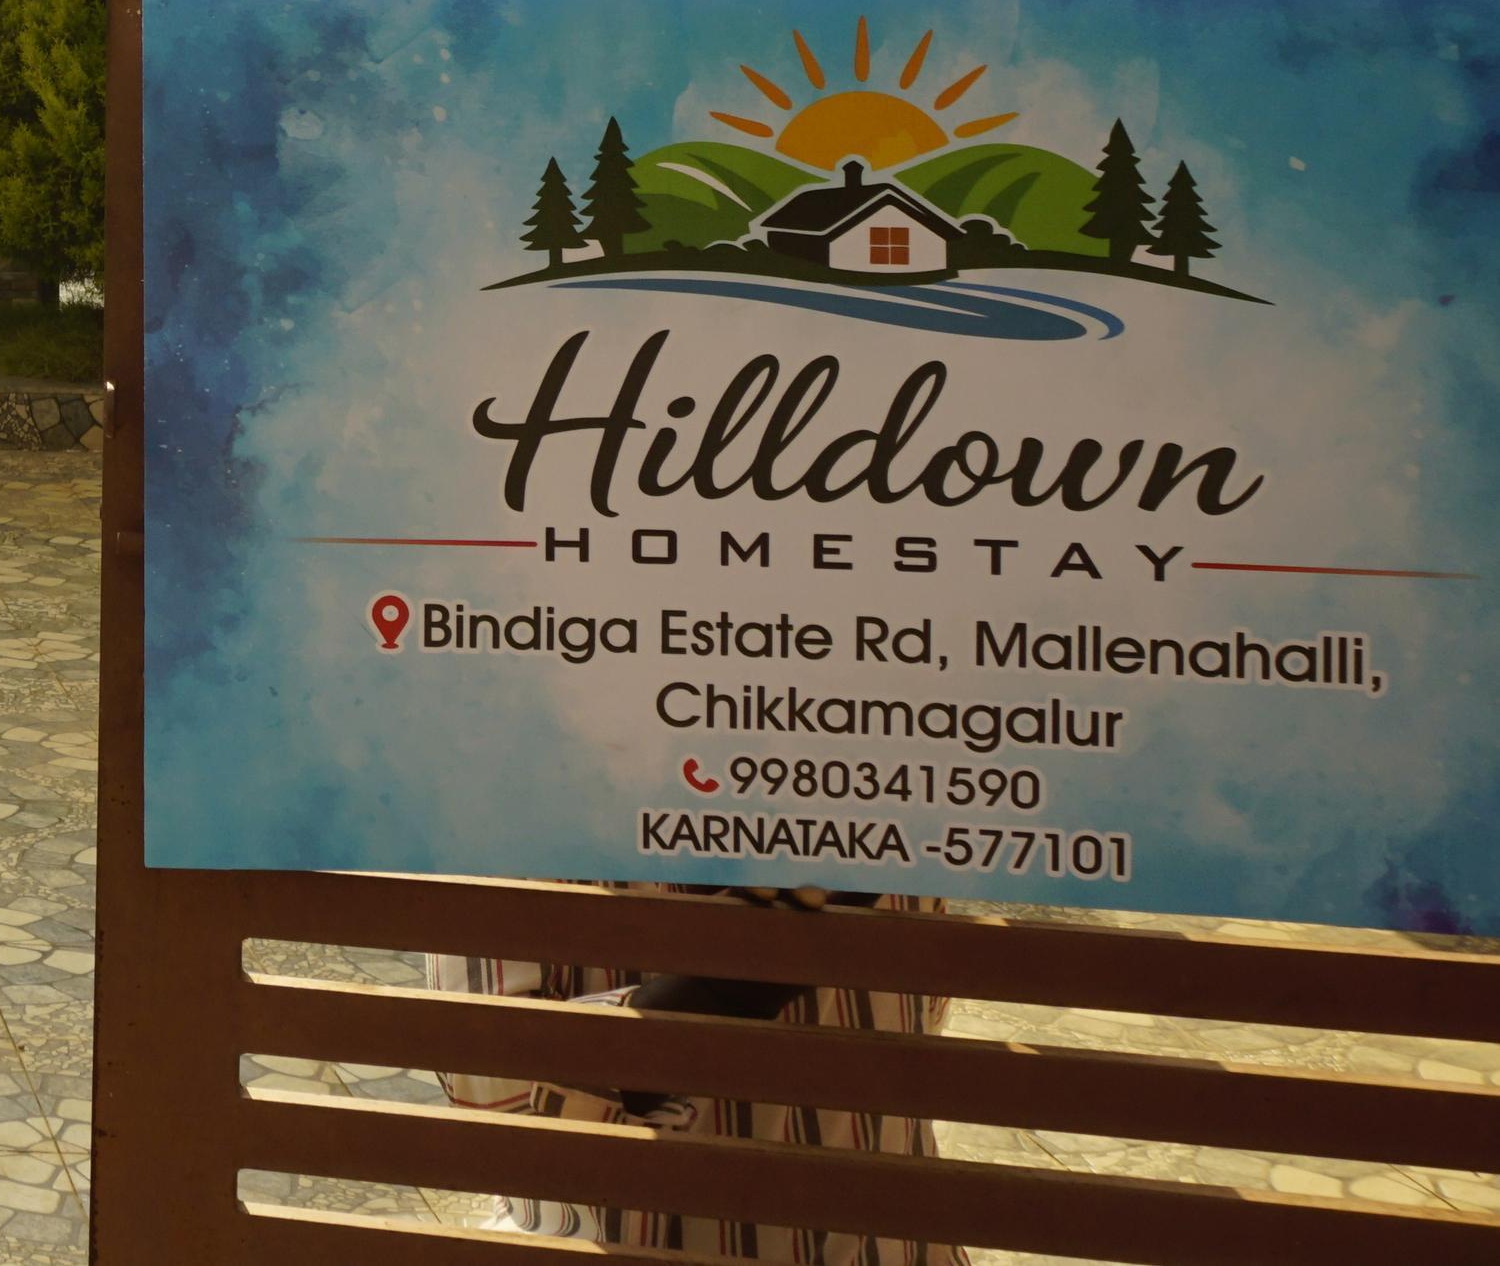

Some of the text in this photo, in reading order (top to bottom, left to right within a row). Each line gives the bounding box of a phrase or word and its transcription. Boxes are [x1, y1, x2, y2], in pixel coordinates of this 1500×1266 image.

[472, 329, 1265, 518] Hilldown
[544, 526, 1184, 582] HOMESTAY
[423, 603, 1382, 693] Bindiga Estate Rd, Mallenahalli,
[655, 681, 1124, 753] Chikkamagalur
[729, 756, 1041, 810] 9980341590
[641, 812, 1126, 876] KARNATAKA -577101
